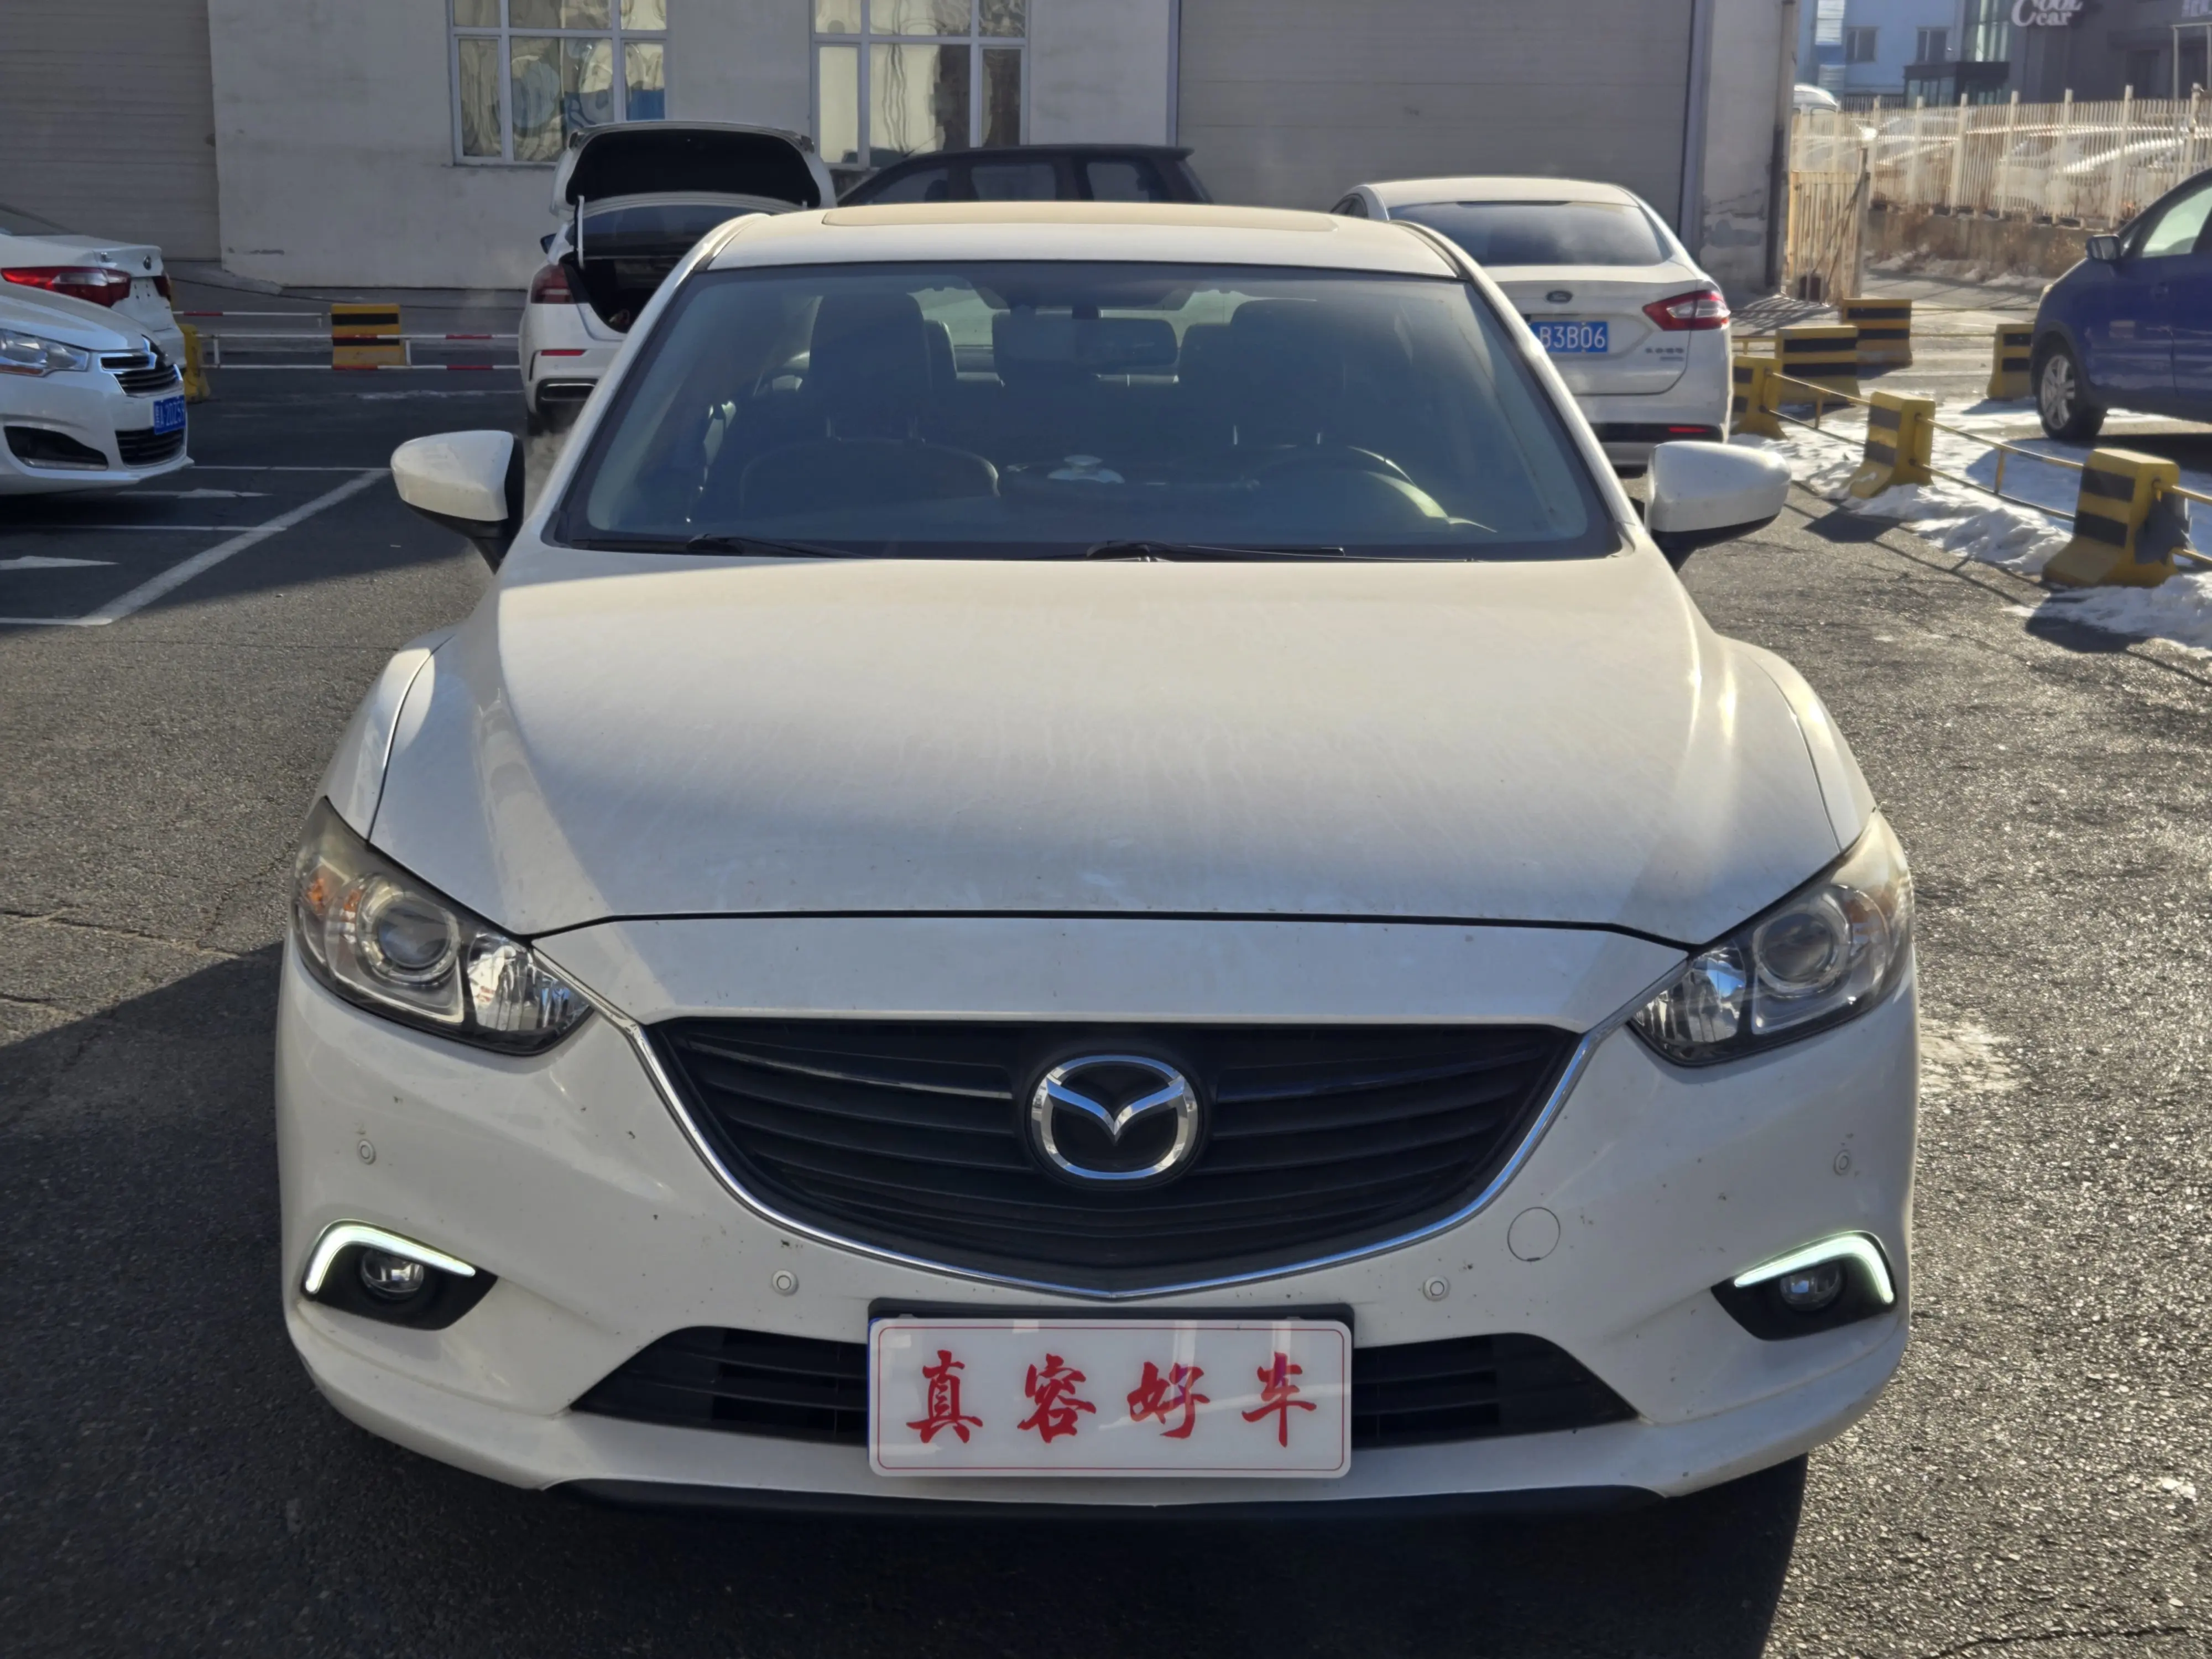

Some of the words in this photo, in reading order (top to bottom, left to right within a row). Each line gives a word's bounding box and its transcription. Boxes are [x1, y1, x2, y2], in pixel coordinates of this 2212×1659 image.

[1540, 326, 1606, 349] B3B06
[906, 1350, 1317, 1447] 真容好车
